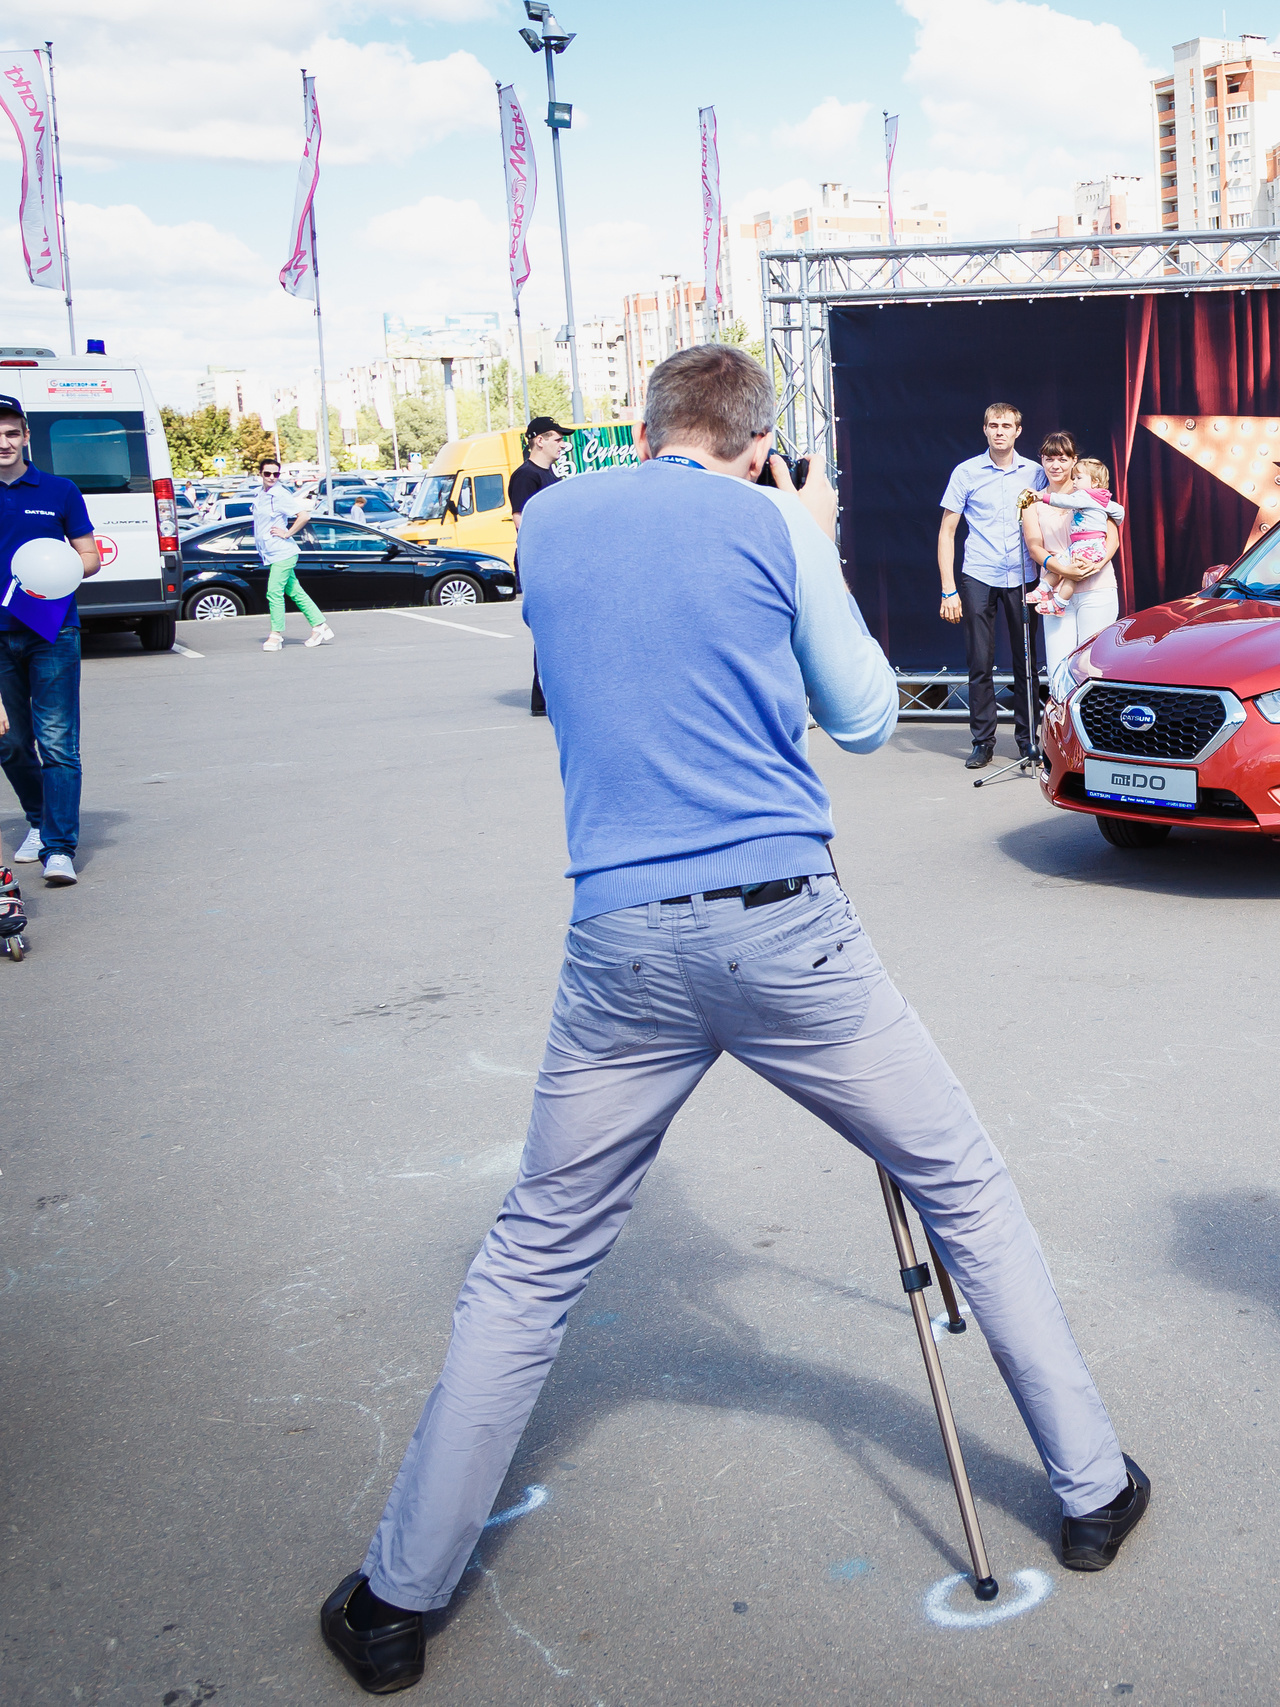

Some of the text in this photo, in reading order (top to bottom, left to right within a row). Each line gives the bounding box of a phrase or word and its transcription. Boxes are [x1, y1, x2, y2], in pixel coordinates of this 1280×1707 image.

[582, 438, 639, 464] Сунду
[24, 509, 56, 517] DATSUN
[1122, 714, 1151, 722] DATSUN
